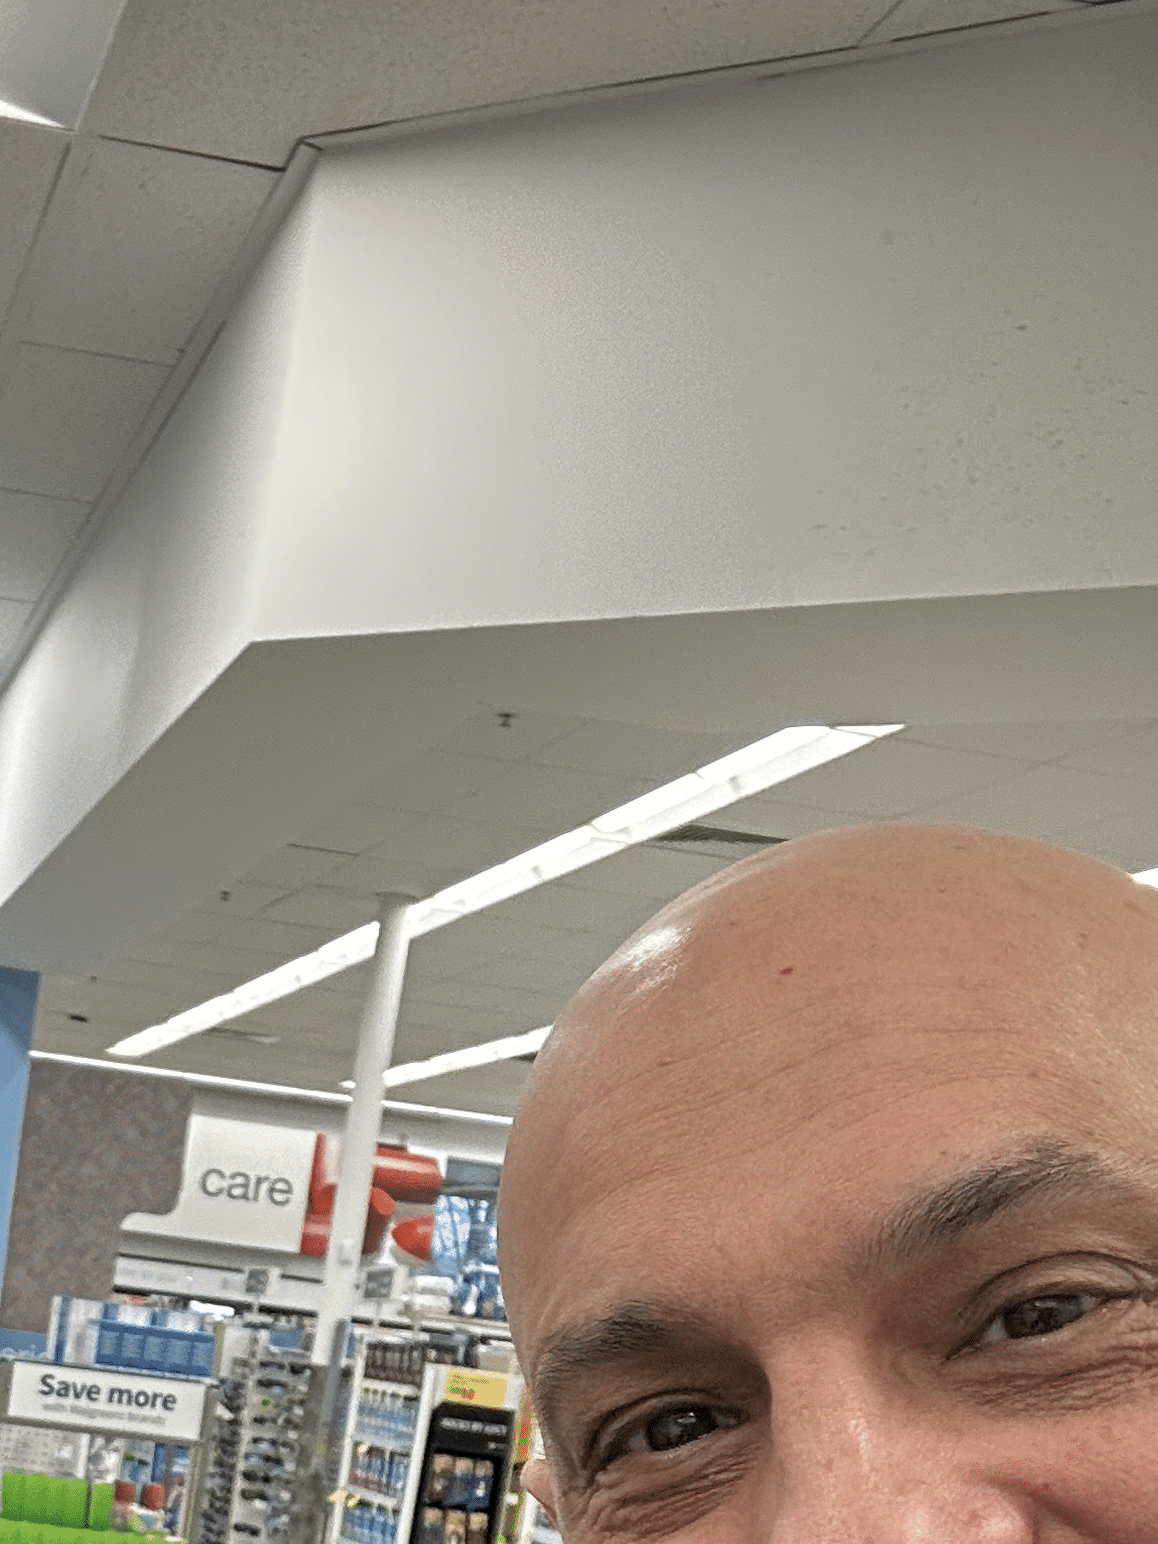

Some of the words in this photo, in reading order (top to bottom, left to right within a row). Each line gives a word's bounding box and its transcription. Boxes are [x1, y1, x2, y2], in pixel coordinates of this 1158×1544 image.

[200, 1168, 293, 1207] care
[38, 1373, 101, 1402] Save
[107, 1385, 177, 1411] more
